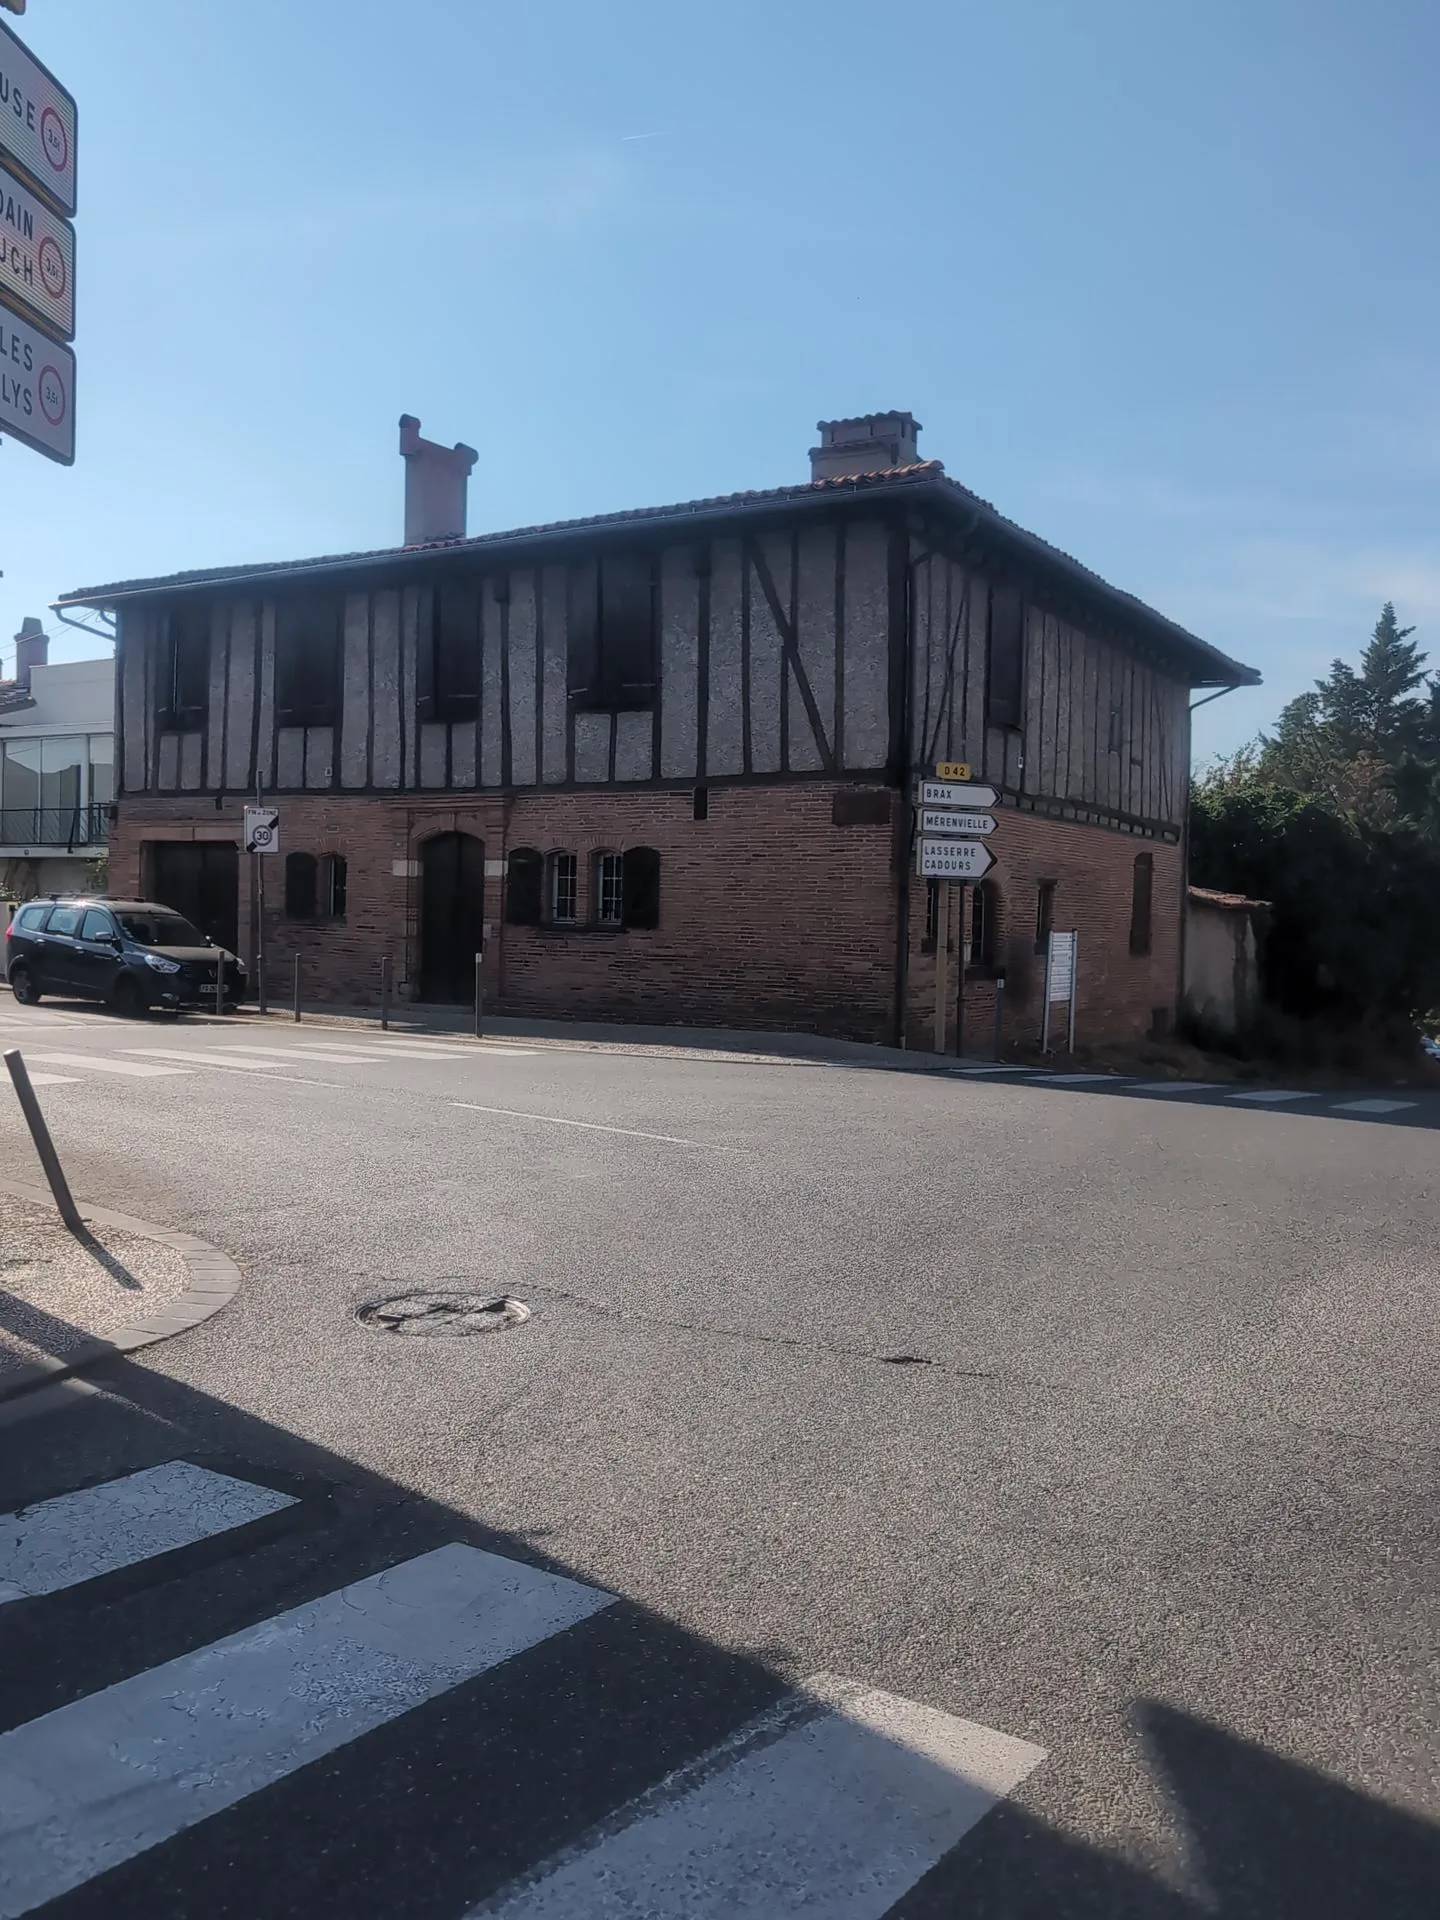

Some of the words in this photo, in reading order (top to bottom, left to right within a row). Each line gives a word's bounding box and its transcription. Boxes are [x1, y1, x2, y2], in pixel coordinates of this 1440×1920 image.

[2, 373, 32, 416] LYS
[944, 766, 950, 775] D
[952, 766, 966, 777] 42
[926, 788, 952, 799] BRAX
[926, 815, 988, 829] MÉRENVIELLE
[257, 831, 268, 840] 30
[924, 846, 976, 857] LASSERRE
[924, 860, 972, 871] CADOURS
